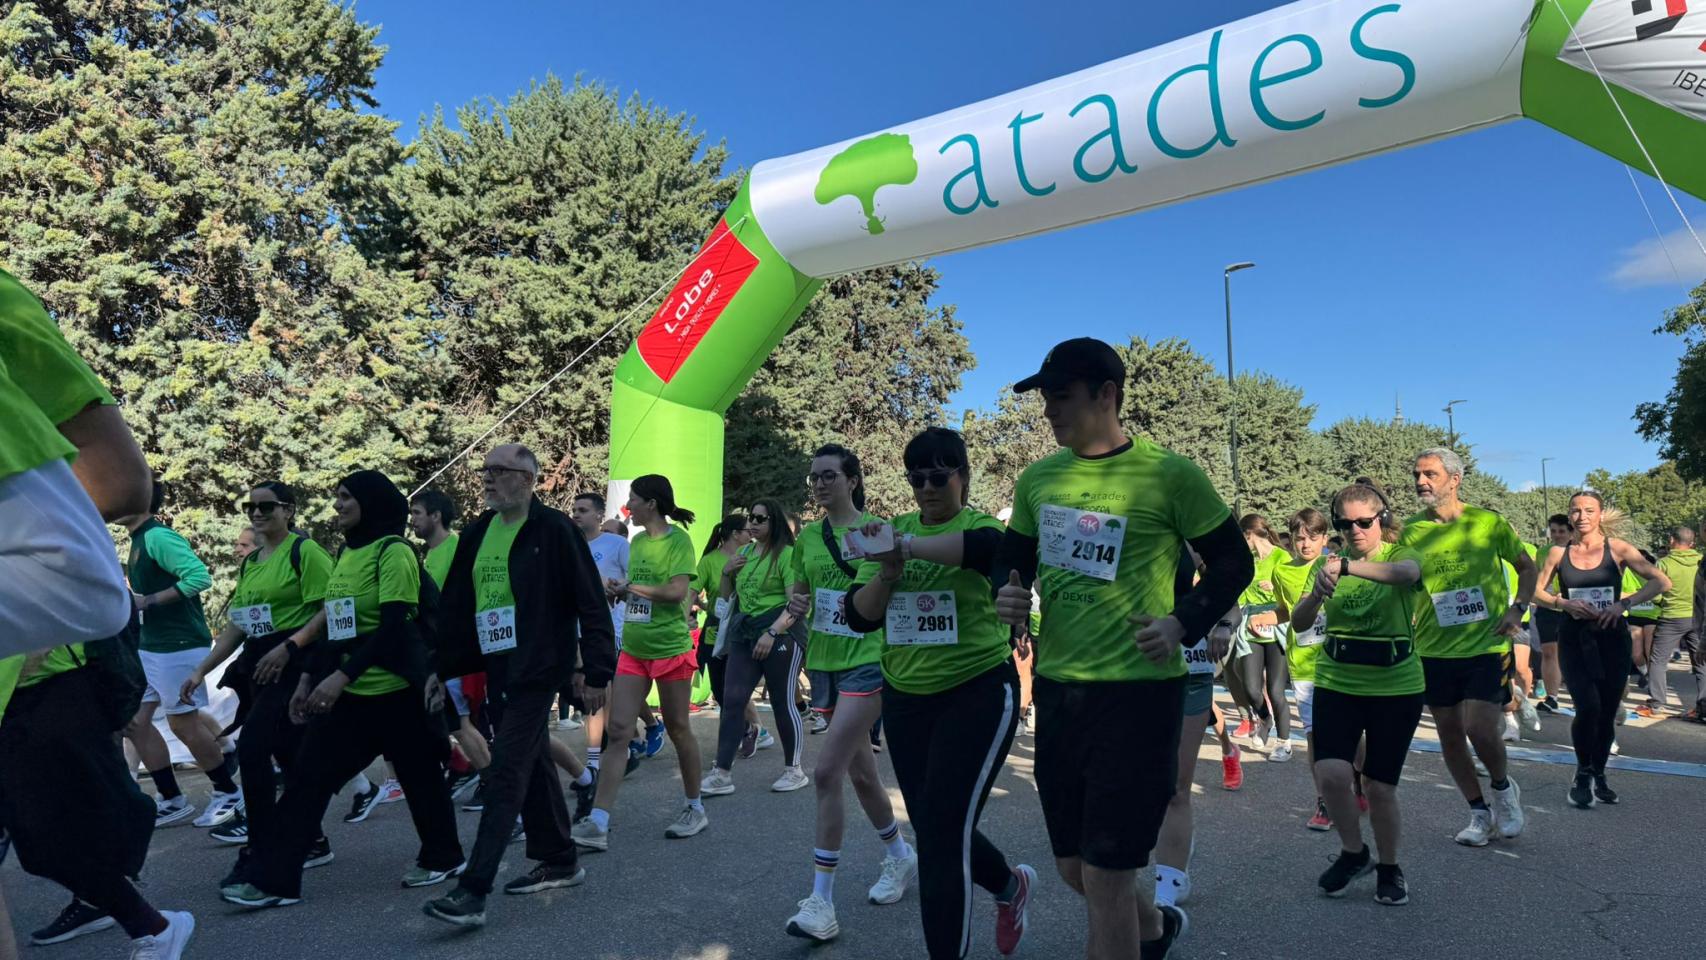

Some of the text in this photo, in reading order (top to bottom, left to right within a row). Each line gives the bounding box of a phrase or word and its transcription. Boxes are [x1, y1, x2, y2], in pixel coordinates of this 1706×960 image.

[938, 3, 1416, 216] atades
[664, 268, 714, 334] Lobe
[1090, 491, 1127, 501] atades
[1079, 519, 1098, 533] 5K
[1071, 540, 1116, 565] 2914
[918, 599, 935, 609] 5K
[1062, 591, 1095, 603] DEXIS
[249, 608, 261, 620] 5K
[1456, 601, 1485, 616] 2886
[488, 613, 499, 623] 5K
[917, 615, 954, 632] 2981
[251, 621, 274, 635] 2576
[488, 626, 513, 642] 2620
[1184, 649, 1212, 664] 349
